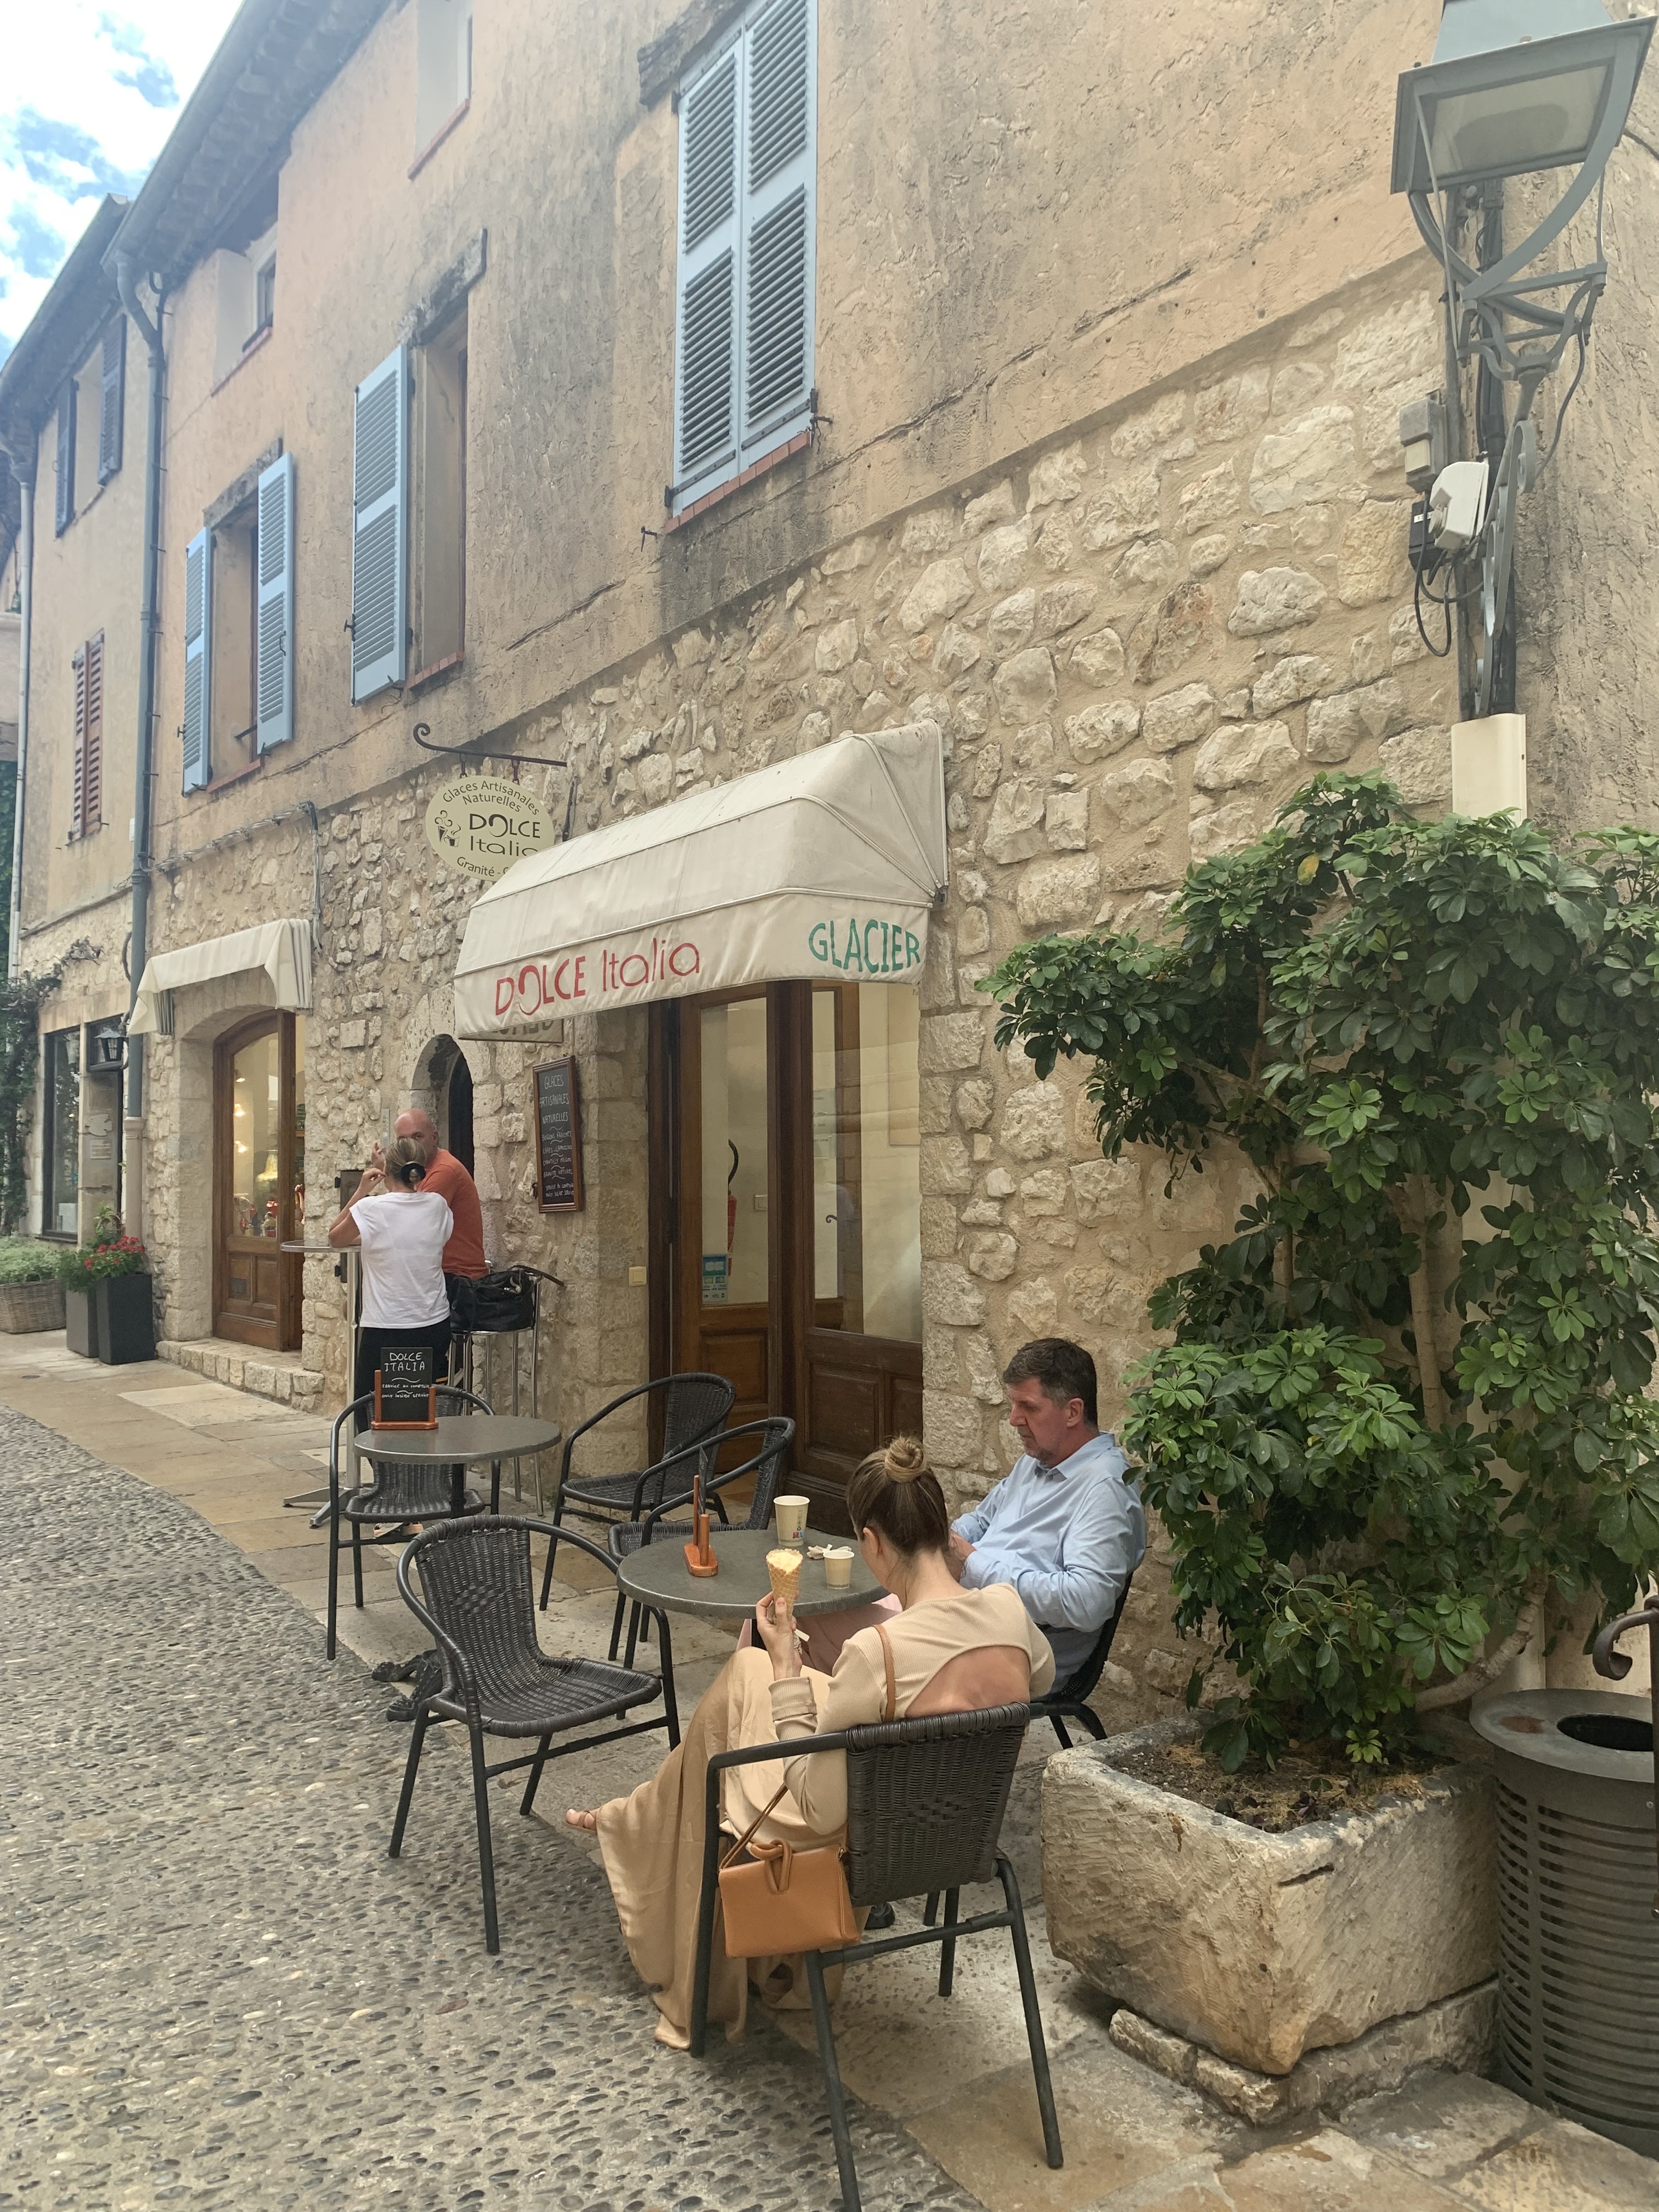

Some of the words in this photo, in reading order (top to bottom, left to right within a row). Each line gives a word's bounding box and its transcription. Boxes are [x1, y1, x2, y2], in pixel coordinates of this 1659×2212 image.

[443, 782, 478, 802] Glaces
[481, 780, 539, 815] Artisanales
[462, 793, 521, 812] Naturelles
[469, 814, 540, 838] DOLCE
[457, 856, 495, 877] Granité
[809, 918, 921, 973] GLACIER
[495, 956, 586, 1015] DOLCE
[603, 938, 699, 991] Italia
[544, 1075, 564, 1089] GLACES
[539, 1093, 569, 1108] ARTISANALES
[543, 1111, 568, 1124] NATURELLES
[390, 1352, 422, 1361] DOLCE
[384, 1361, 425, 1372] ITALIA
